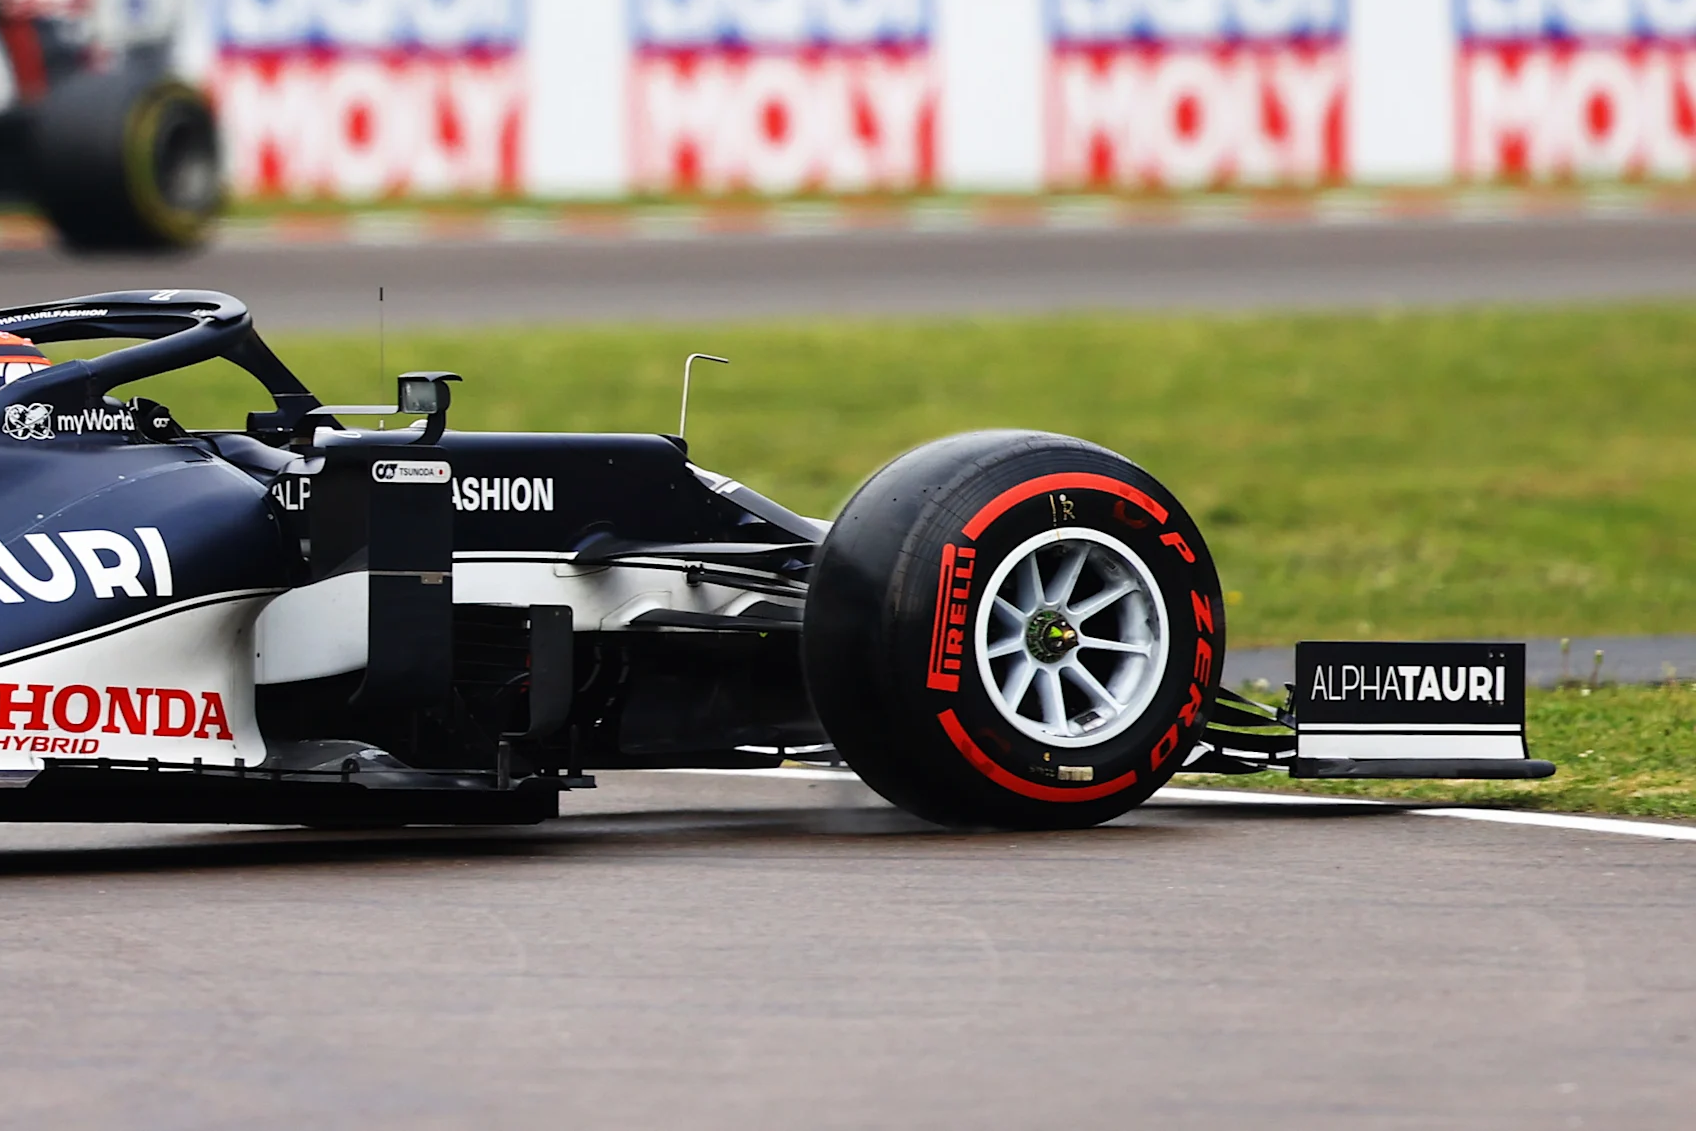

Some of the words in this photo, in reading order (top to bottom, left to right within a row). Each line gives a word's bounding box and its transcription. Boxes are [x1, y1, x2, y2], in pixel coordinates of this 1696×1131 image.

[234, 54, 520, 188] MOLY
[648, 54, 936, 187] MOLY
[1064, 52, 1344, 182] MOLY
[57, 408, 136, 435] myWorld
[1159, 532, 1197, 564] P
[926, 542, 978, 692] PIRELLI
[1150, 589, 1214, 771] ZERO
[1310, 664, 1506, 702] ALPHATAURI
